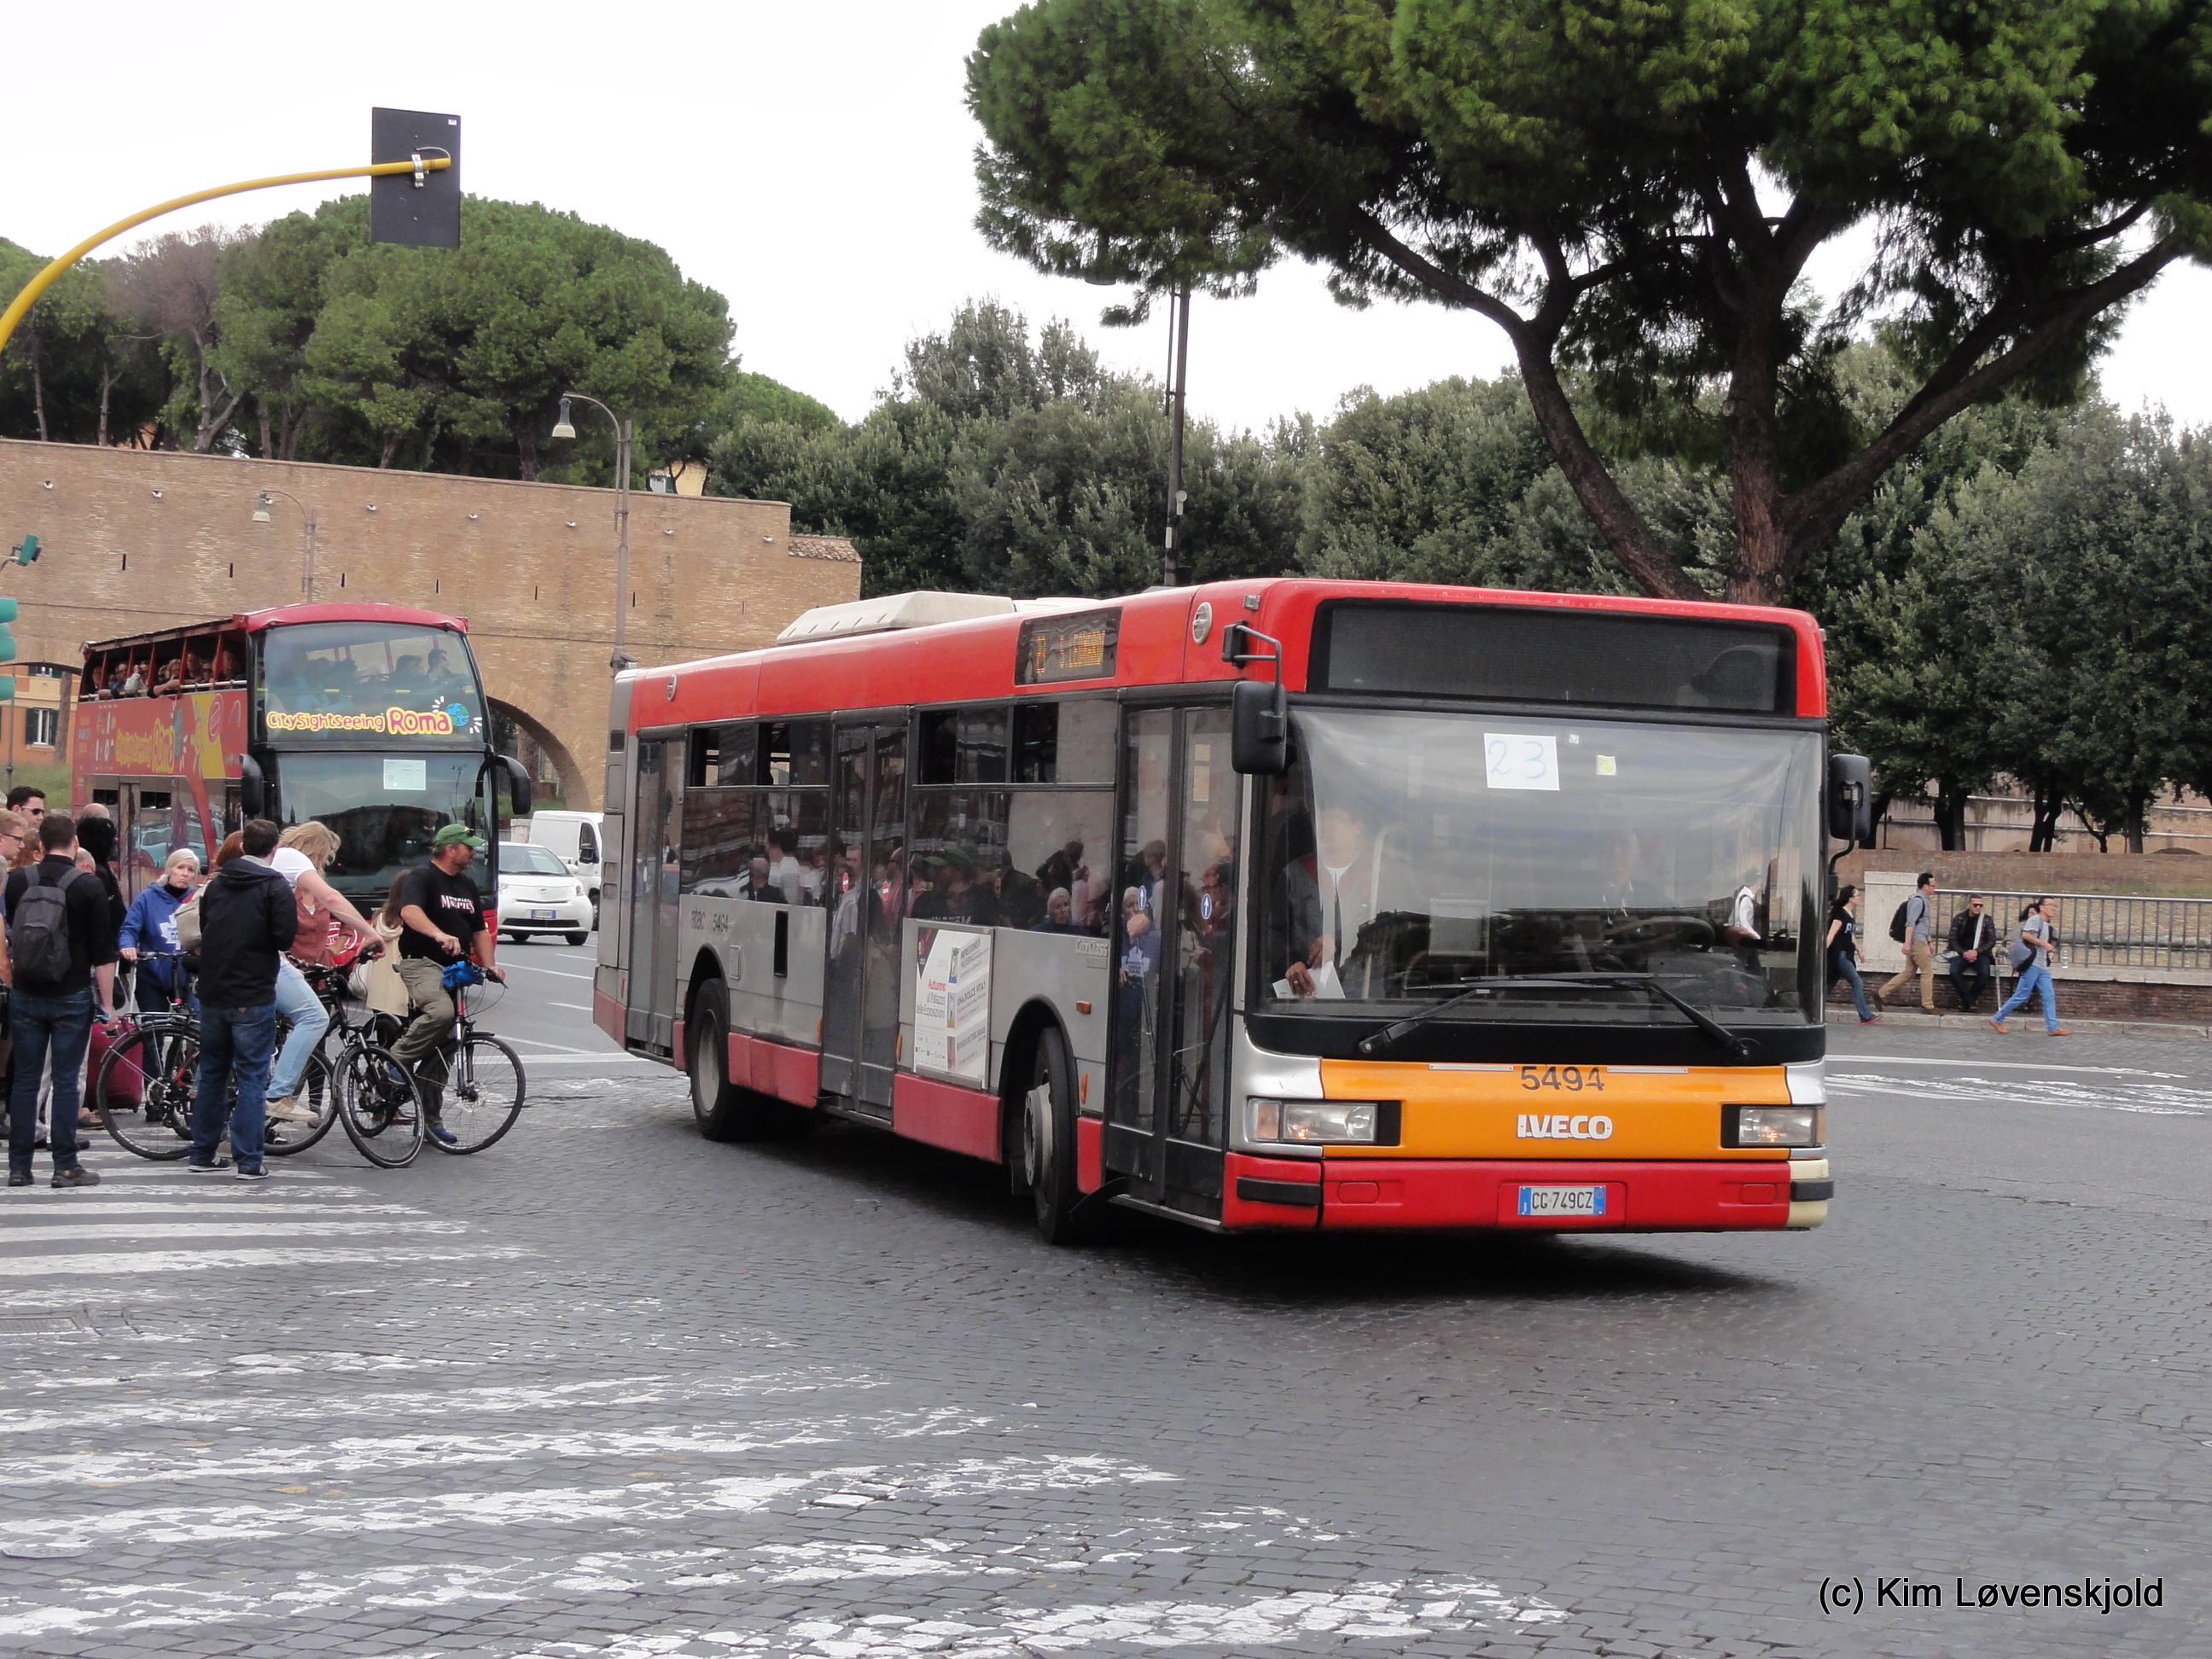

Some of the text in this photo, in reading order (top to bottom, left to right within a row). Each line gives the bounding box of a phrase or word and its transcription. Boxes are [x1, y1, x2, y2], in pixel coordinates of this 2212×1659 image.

[267, 711, 385, 732] CitySightseeing
[1488, 740, 1547, 779] 23
[1521, 1066, 1605, 1091] 5494
[1516, 1115, 1613, 1139] IVECO
